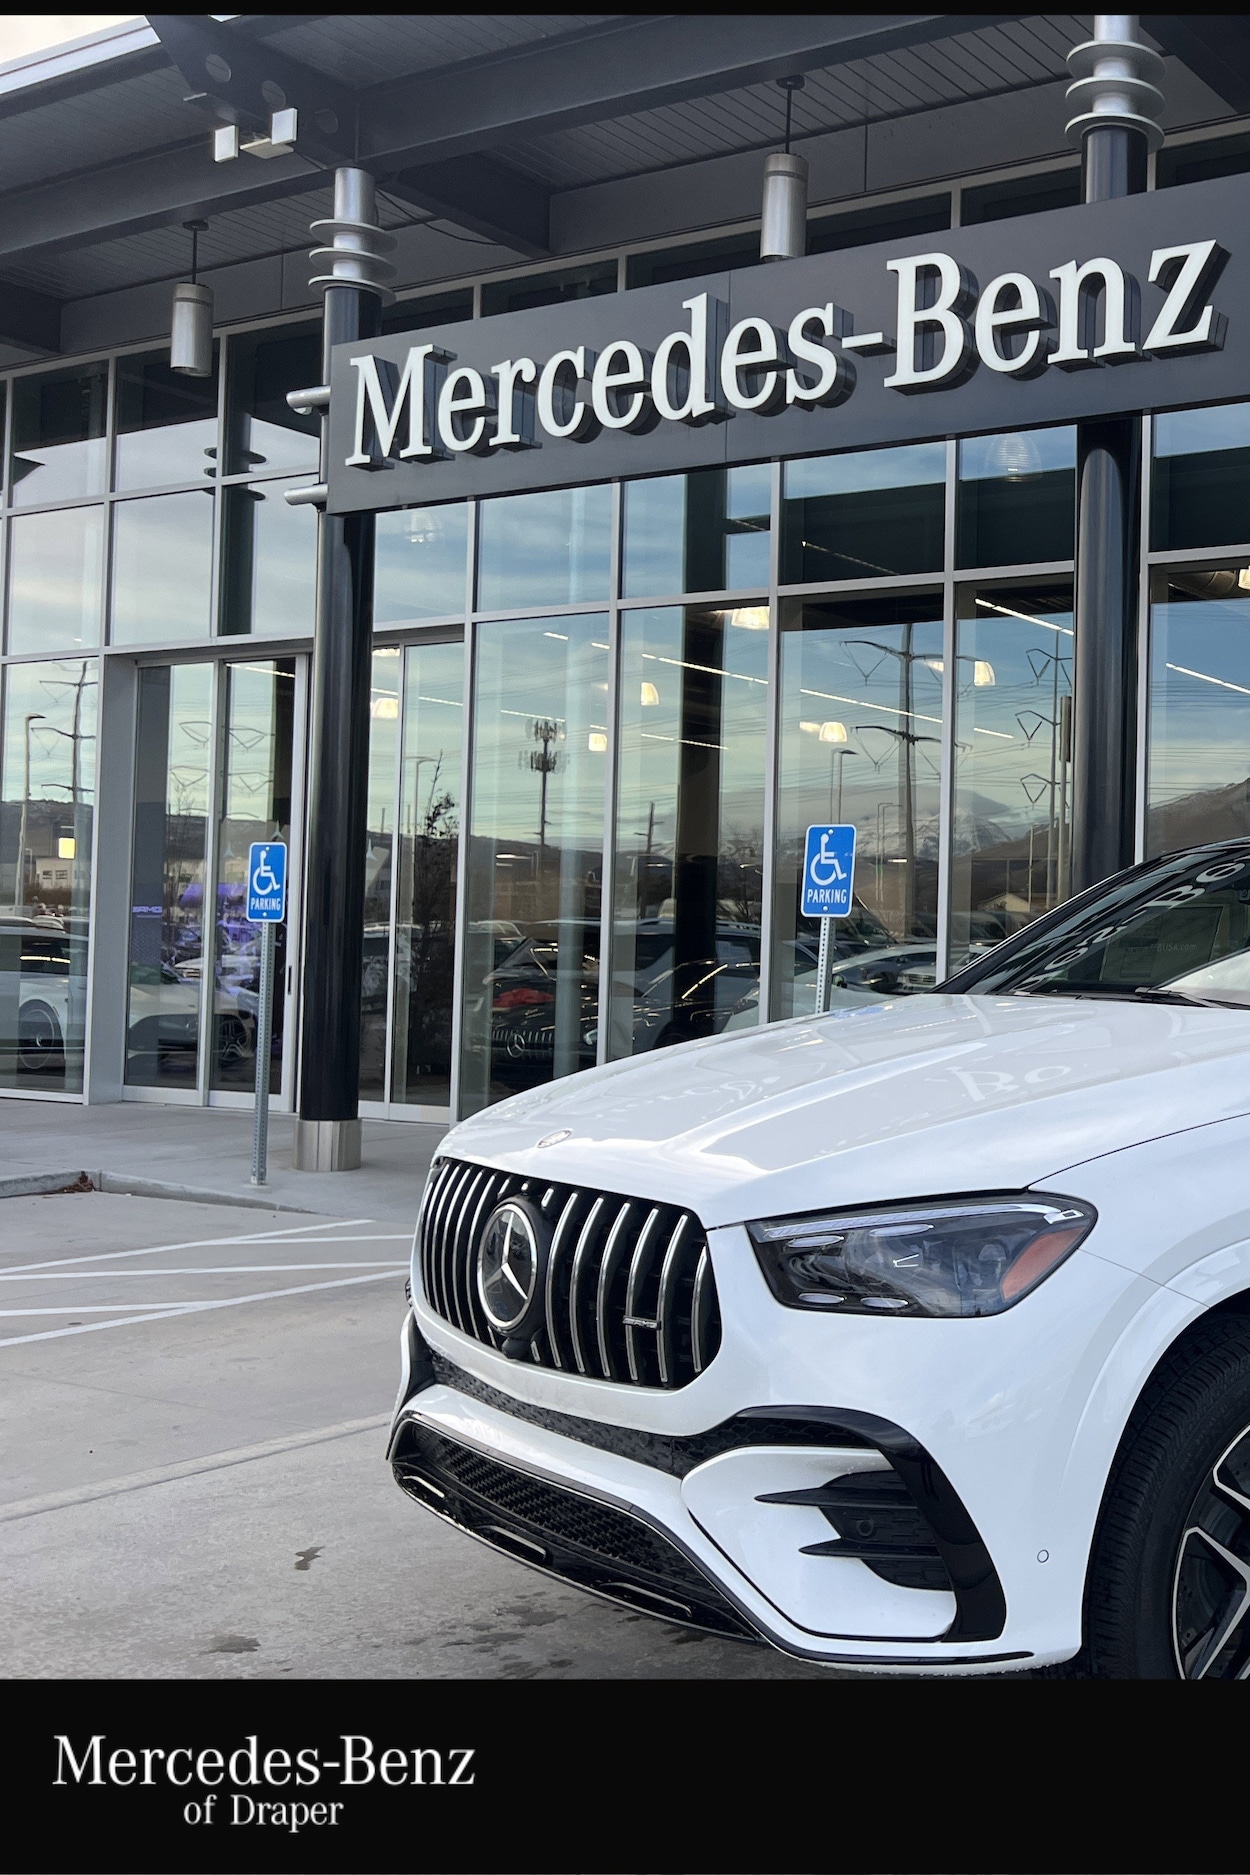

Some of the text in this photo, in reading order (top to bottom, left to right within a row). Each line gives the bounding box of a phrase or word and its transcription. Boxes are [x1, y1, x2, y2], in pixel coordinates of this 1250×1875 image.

[345, 239, 1217, 467] Mercedes-Benz
[250, 897, 281, 911] PARKING
[806, 888, 847, 904] PARKING
